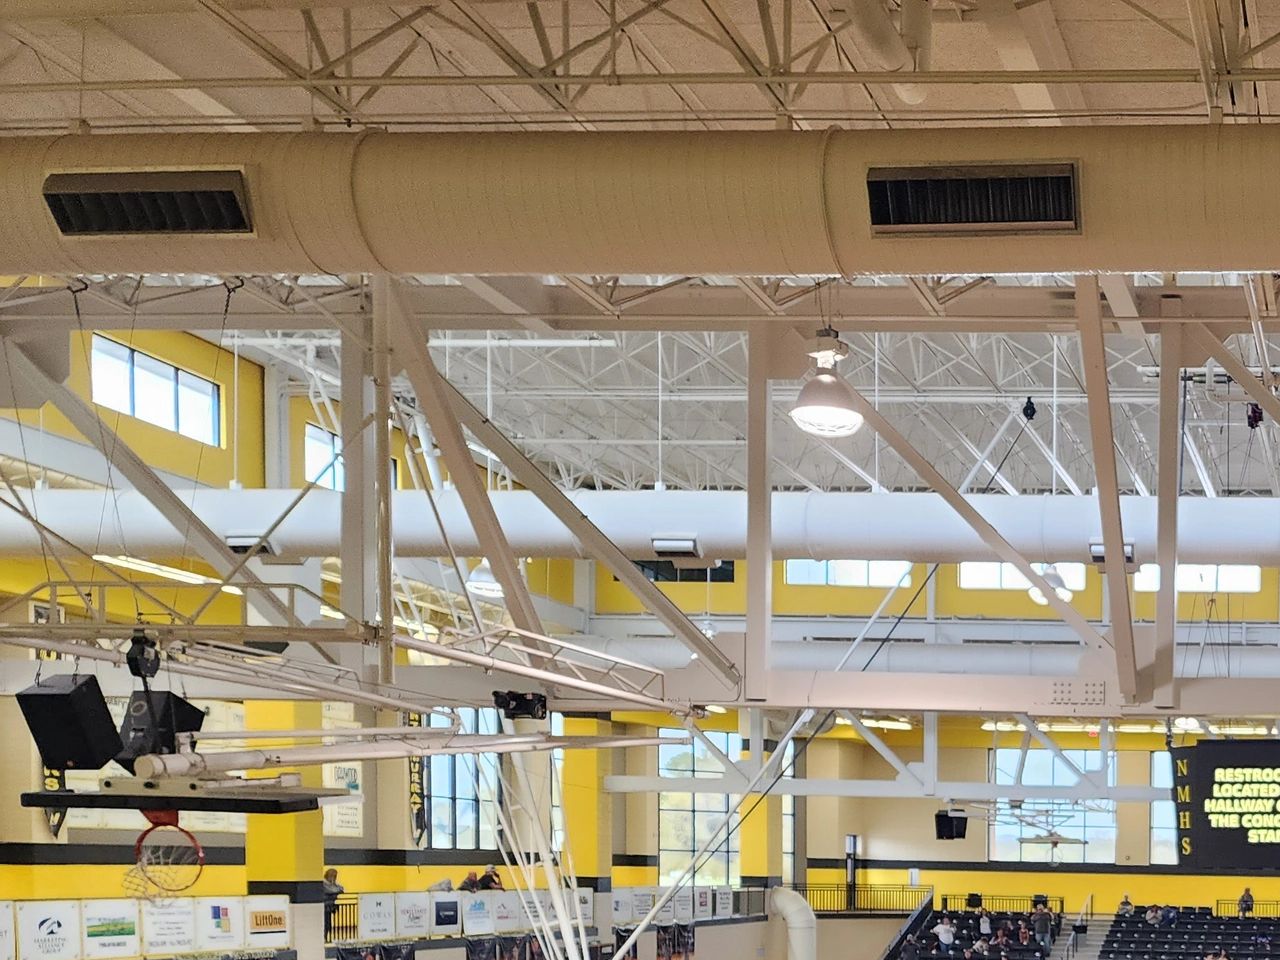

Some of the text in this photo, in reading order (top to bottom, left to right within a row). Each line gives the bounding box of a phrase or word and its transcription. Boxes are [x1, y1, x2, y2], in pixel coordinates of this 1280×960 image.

[1212, 783, 1280, 798] LOCATED
[1204, 798, 1275, 813] HALLWAY
[1208, 814, 1240, 828] THE
[254, 914, 283, 927] LiftOne
